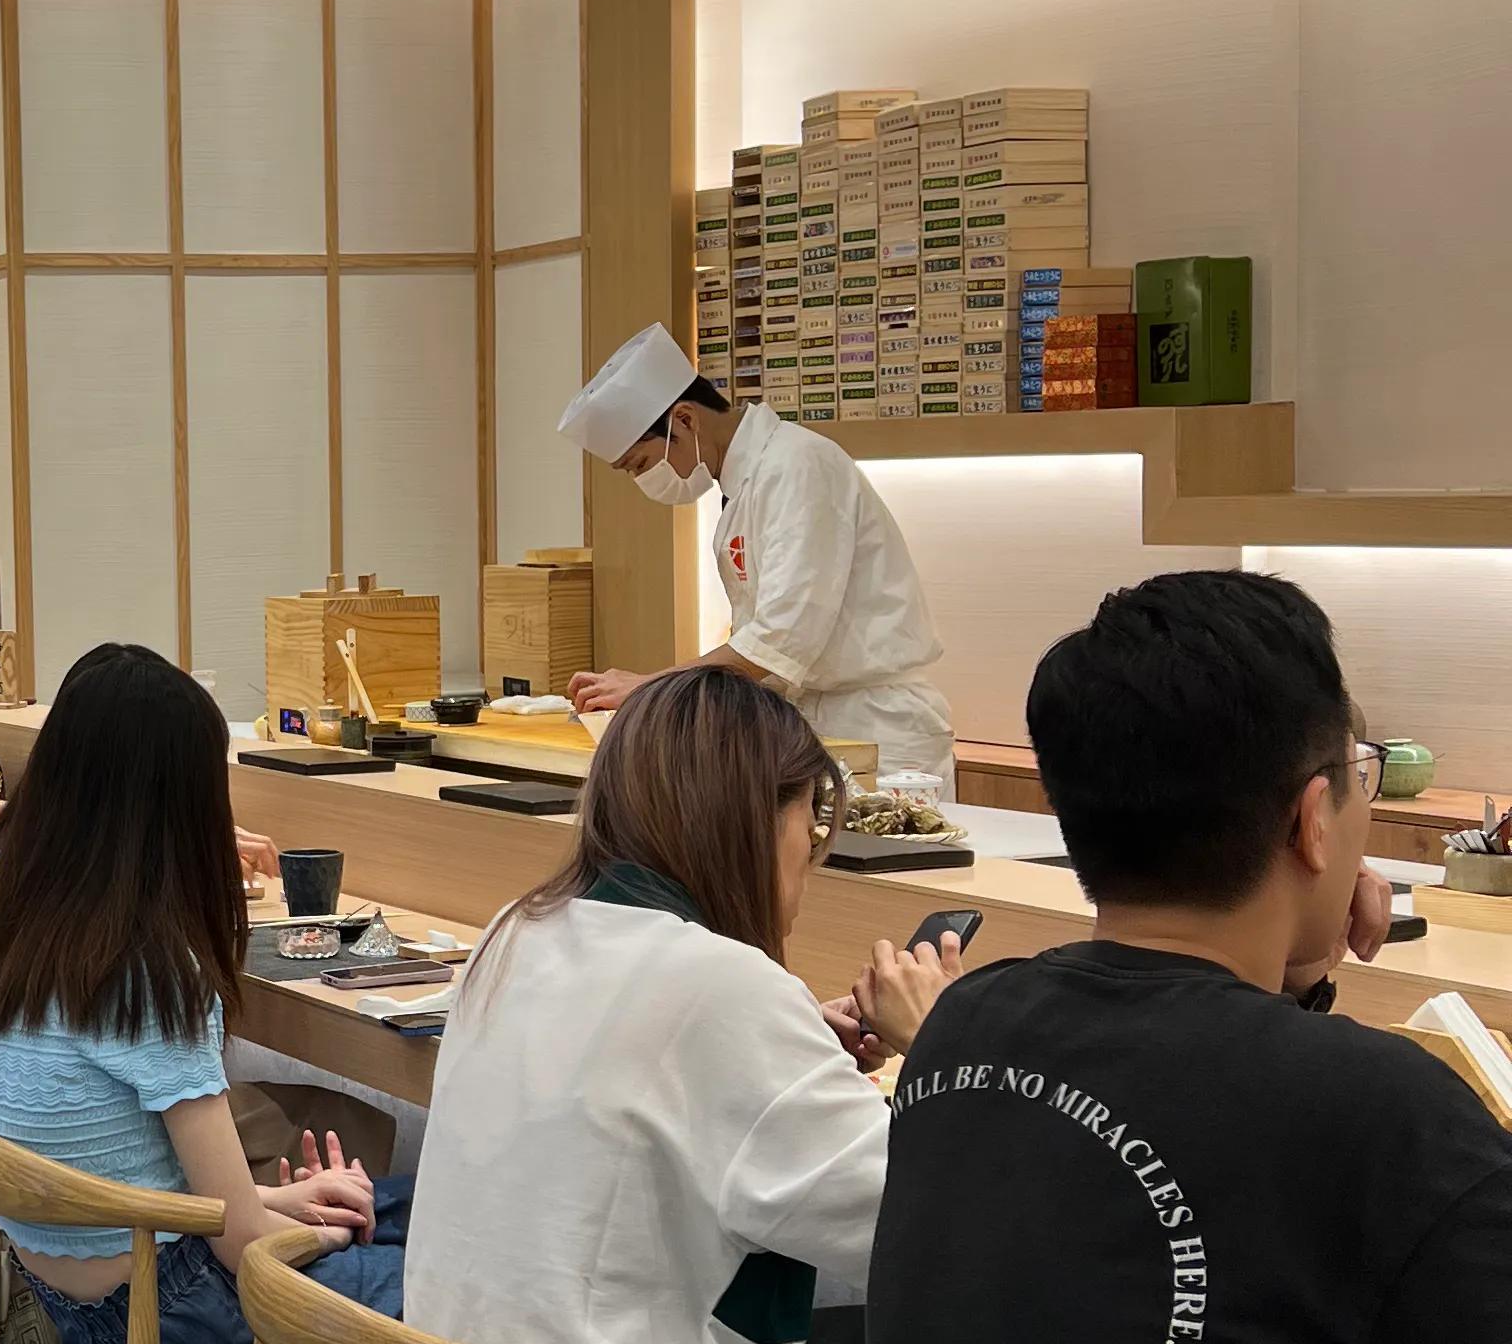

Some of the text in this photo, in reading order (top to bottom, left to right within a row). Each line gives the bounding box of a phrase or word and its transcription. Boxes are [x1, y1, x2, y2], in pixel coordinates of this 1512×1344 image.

[953, 1064, 994, 1090] BE
[997, 1066, 1045, 1099] NO
[1046, 1082, 1194, 1228] MIRACLES
